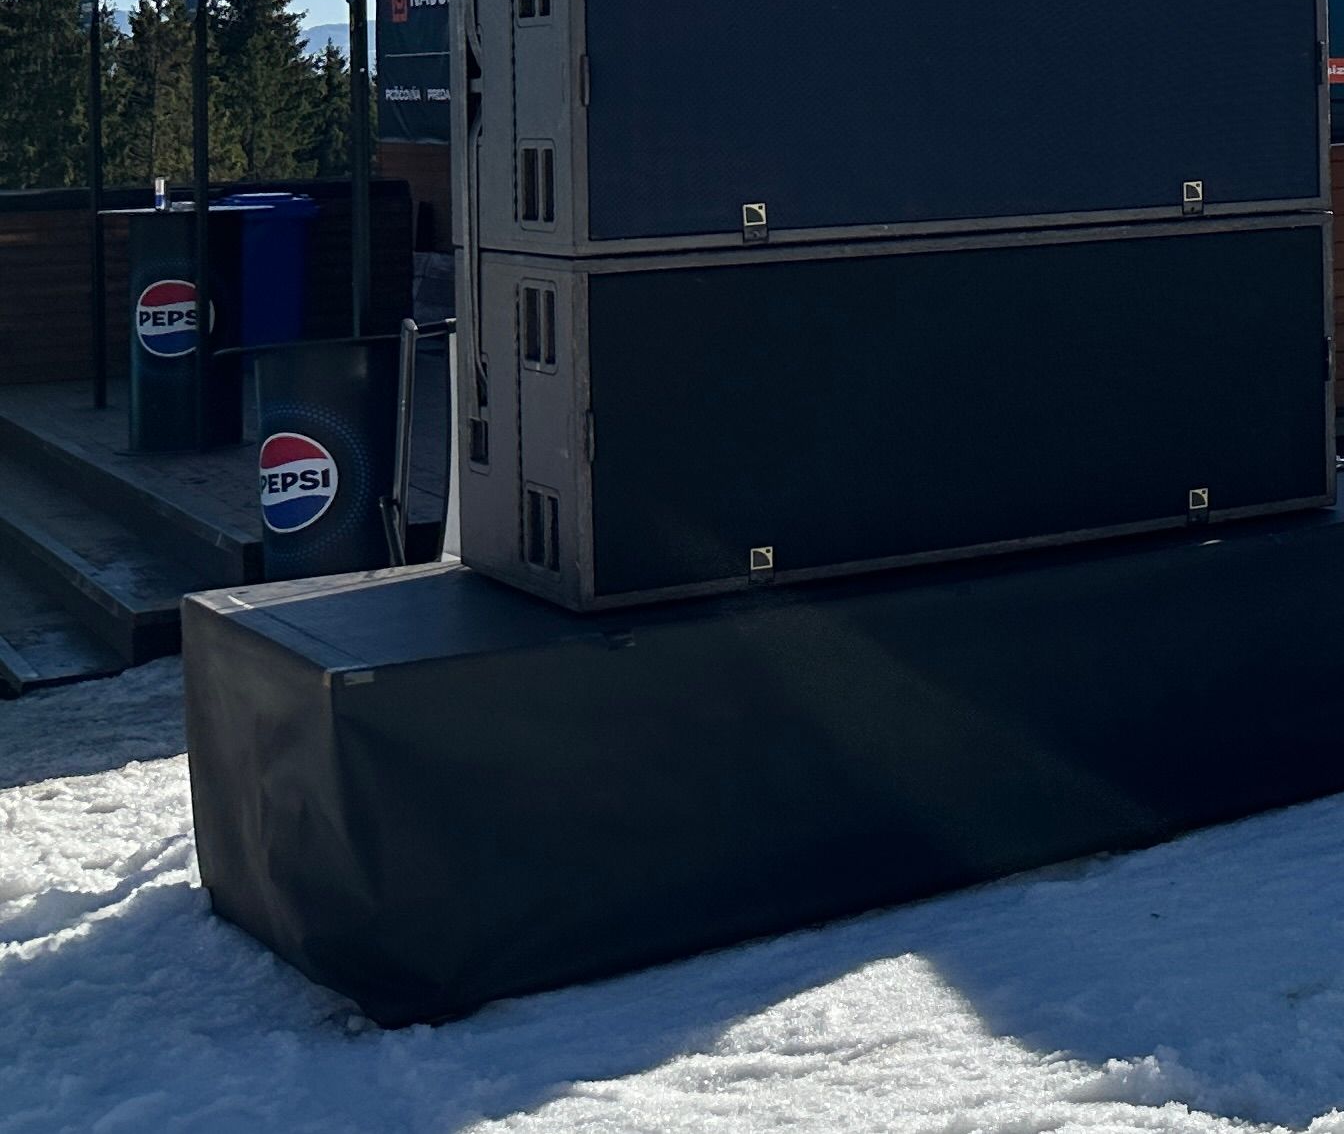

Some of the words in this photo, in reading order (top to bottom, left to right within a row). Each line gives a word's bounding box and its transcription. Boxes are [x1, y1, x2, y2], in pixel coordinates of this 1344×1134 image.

[427, 88, 451, 101] PREDA
[139, 309, 198, 327] PEPS
[260, 468, 331, 495] PEPSI
